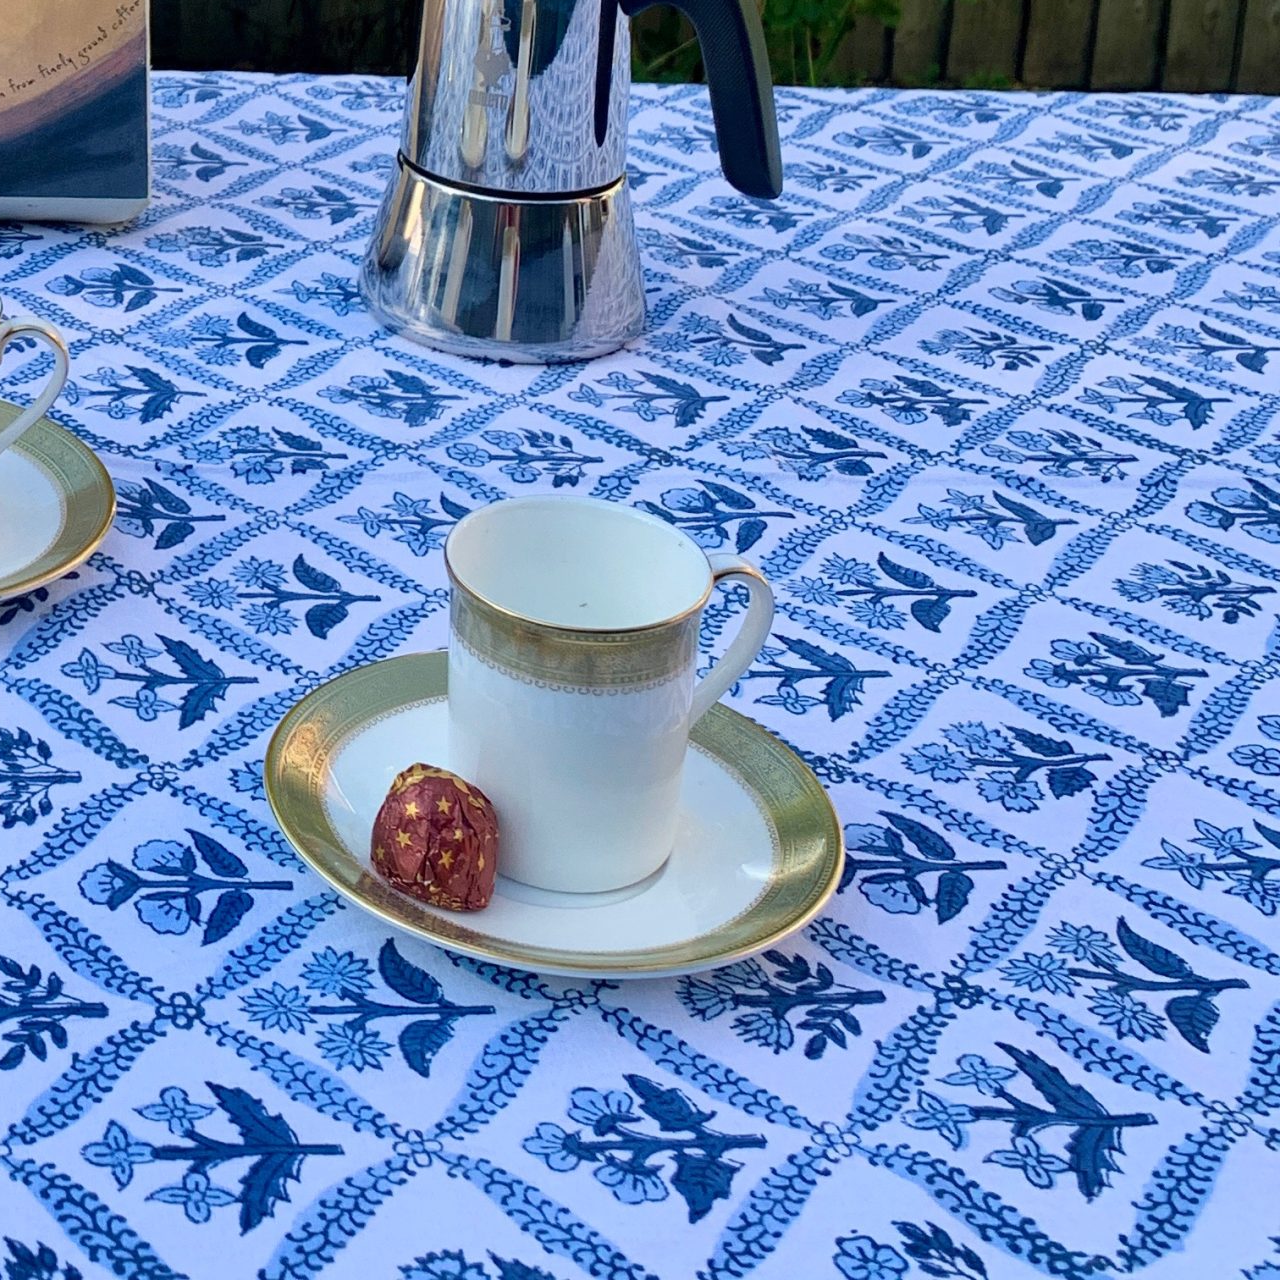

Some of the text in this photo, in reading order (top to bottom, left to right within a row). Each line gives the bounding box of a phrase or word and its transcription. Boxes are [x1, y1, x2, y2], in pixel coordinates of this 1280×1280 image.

[8, 78, 36, 93] from
[37, 52, 78, 78] finely
[78, 25, 108, 66] ground
[111, 0, 140, 31] coffee
